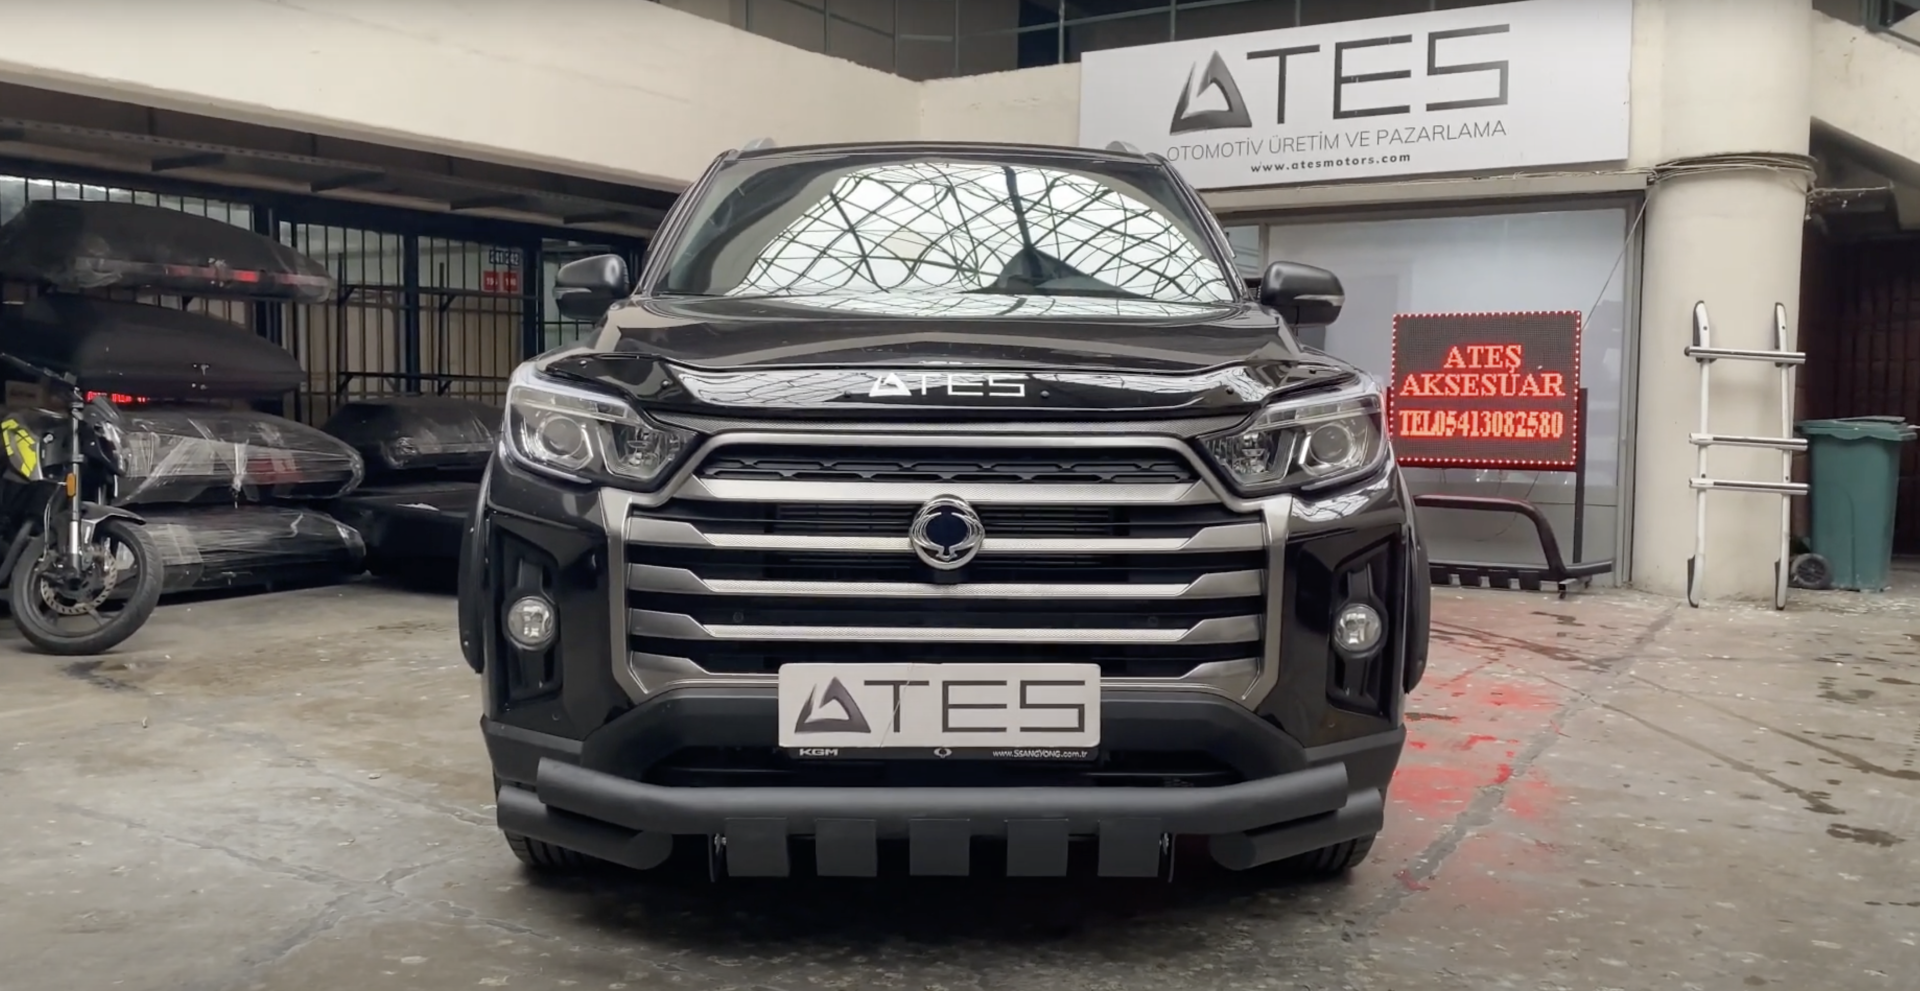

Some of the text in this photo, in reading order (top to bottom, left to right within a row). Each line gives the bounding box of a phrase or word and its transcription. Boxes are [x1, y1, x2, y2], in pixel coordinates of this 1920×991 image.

[1169, 24, 1510, 135] ATES
[1167, 120, 1507, 162] OTOMOTİV ÜRETİM VE PAZARLAMA
[1250, 153, 1411, 173] www.atesmotors.com
[1443, 344, 1522, 373] ATEŞ
[868, 372, 1027, 397] ATES
[1400, 373, 1566, 397] AKSESUAR
[1399, 409, 1564, 438] TEL05413082580
[794, 676, 1086, 733] ATES
[799, 748, 839, 756] KGM
